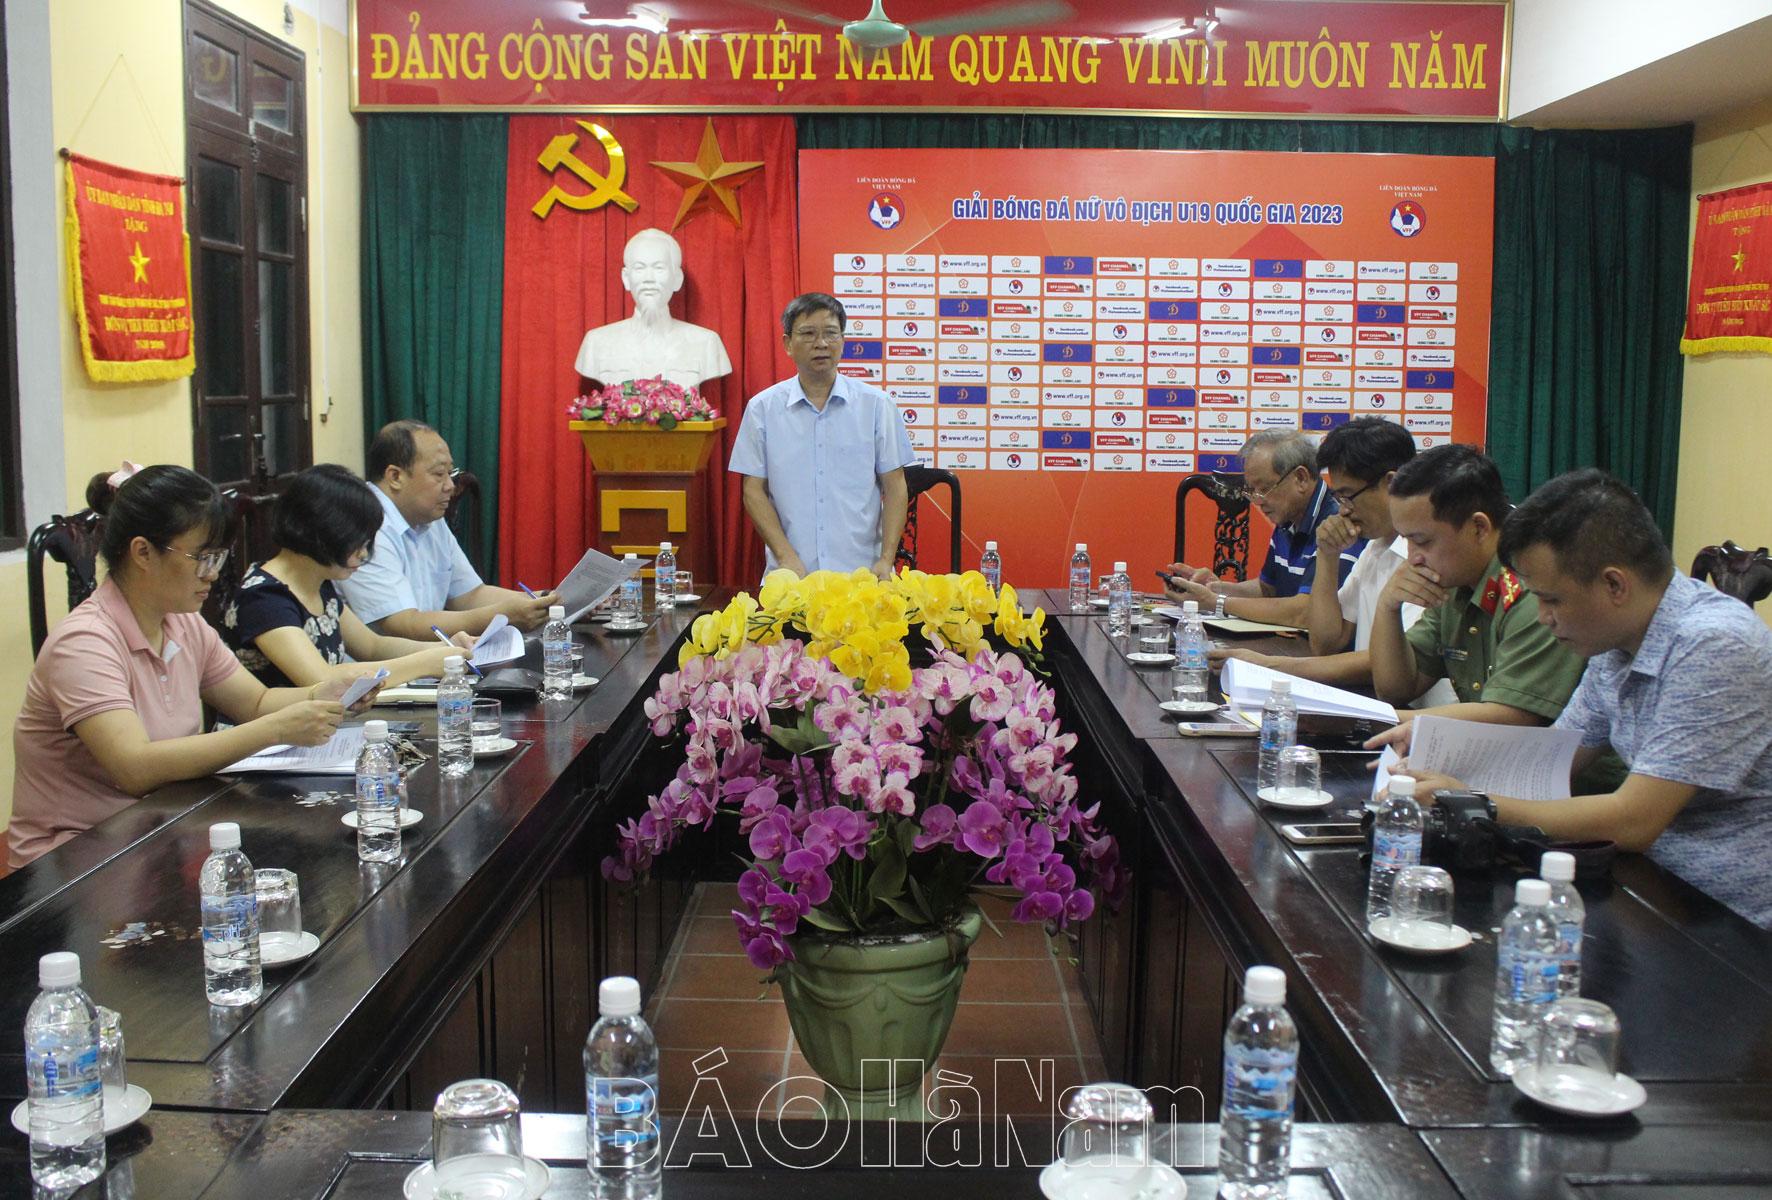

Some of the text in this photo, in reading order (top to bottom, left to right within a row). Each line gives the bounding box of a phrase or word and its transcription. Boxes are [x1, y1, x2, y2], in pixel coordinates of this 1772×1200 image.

[371, 12, 489, 80] ĐẢNG
[500, 18, 613, 92] CỘNG
[722, 19, 821, 92] VIỆT
[835, 33, 934, 81] NAM
[949, 34, 1101, 86] QUANG
[1245, 27, 1369, 88] MUÔN
[1389, 30, 1486, 89] NĂM
[953, 191, 1343, 227] GIẢI BÓNG ĐÁ NỮ VÔ ĐỊCH U19 QUỐC GIA 2023
